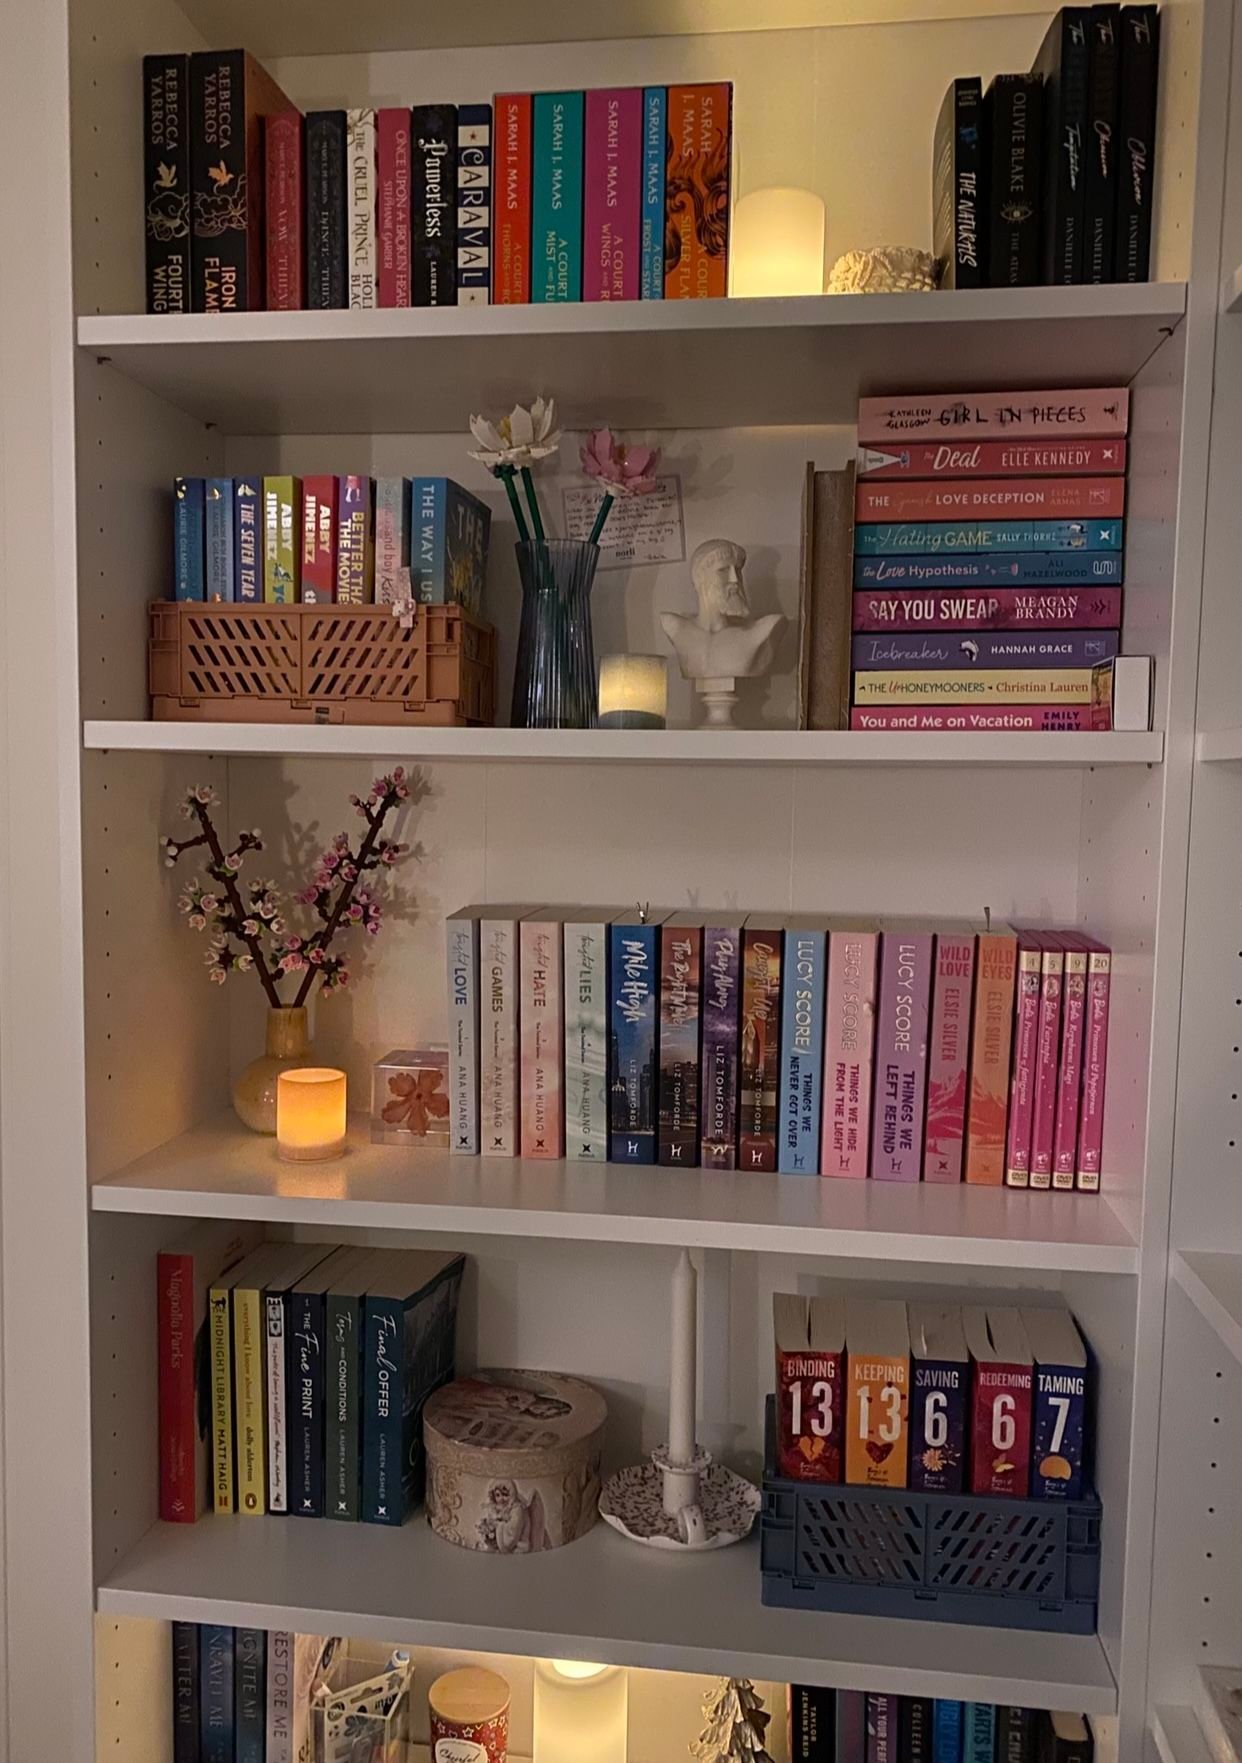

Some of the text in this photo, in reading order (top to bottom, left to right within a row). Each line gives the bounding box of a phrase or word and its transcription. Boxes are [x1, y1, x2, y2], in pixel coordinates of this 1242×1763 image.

[152, 76, 164, 145] YARROS
[166, 69, 178, 150] REBECCA
[204, 74, 218, 144] YARROS
[218, 66, 231, 149] REBECCA
[682, 94, 695, 158] J. MAAS
[701, 97, 712, 152] SARAH
[507, 104, 519, 210] SARAH J. MAAS
[552, 104, 564, 211] SARAH J. MAAS
[606, 100, 619, 208] SARAH J. MAAS
[648, 98, 660, 205] SARAH J. MAAS
[1010, 92, 1026, 193] OLIVIE BLAKE
[354, 155, 369, 267] CRUEL PRINCE
[418, 138, 448, 238] Powerless
[462, 148, 485, 285] CARAVAL
[958, 172, 978, 268] THE NATURALS
[558, 239, 569, 298] A COURT
[600, 223, 612, 268] WINGS
[153, 266, 167, 312] WING
[221, 267, 236, 308] IRON
[430, 262, 438, 298] LAUREN
[613, 250, 624, 296] COURT
[653, 255, 662, 293] COURT
[938, 405, 1087, 427] GIRL IN PIECES
[932, 446, 982, 471] Deal
[1002, 450, 1092, 467] ELLE KENNEDY
[421, 484, 434, 562] THE WAY
[868, 492, 1045, 508] THE LOVE DECEPTION
[266, 492, 278, 560] JIMENEZ
[281, 503, 292, 552] ABBY
[304, 494, 316, 564] JIMENEZ
[320, 504, 331, 554] ABBY
[339, 518, 352, 549] THE
[351, 512, 364, 572] BETTER
[878, 525, 992, 551] Hating GAME
[180, 538, 188, 580] GILMORE
[241, 504, 255, 598] THE SEVEN YEAR
[876, 561, 980, 581] Love Hypothesis
[869, 598, 1000, 621] SAY YOU SWEAR
[1014, 596, 1079, 607] MEAGAN
[1015, 608, 1078, 619] BRANDY
[868, 640, 949, 662] Icebreaker
[990, 644, 1073, 654] HANNAH GRACE
[868, 682, 888, 694] THE
[996, 682, 1089, 694] Christina Lauren
[860, 714, 1034, 728] You and Me on Vacation
[1044, 711, 1080, 721] EMILY
[939, 962, 970, 979] LOVE
[940, 945, 972, 962] WILD
[1049, 958, 1056, 969] 5
[1074, 958, 1081, 969] 9
[1094, 958, 1108, 969] 20
[454, 968, 468, 1006] LOVE
[492, 966, 504, 1014] GAMES
[533, 970, 546, 1008] HATE
[579, 970, 592, 1005] LIES
[616, 940, 648, 1023] Mile High
[794, 940, 814, 1047] LUCY SCORE
[894, 944, 916, 1052] LUCY SCORE
[941, 988, 960, 1062] ELSIE SILVER
[459, 1065, 468, 1088] ANA
[494, 1065, 502, 1088] ANA
[536, 1068, 544, 1091] ANA
[630, 1059, 638, 1126] LIZ TOMFORDE
[673, 1063, 682, 1132] LIZ TOMFORDE
[715, 1046, 725, 1136] LIZ TOMFORDE
[459, 1092, 468, 1130] HUANG
[494, 1092, 503, 1129] HUANG
[536, 1094, 544, 1132] HUANG
[754, 1086, 762, 1137] TOMFORDE
[788, 1056, 800, 1148] NEVER GOT OVER
[801, 1072, 813, 1133] THINGS WE
[833, 1062, 846, 1152] FROM THE LIGHT
[848, 1063, 860, 1152] THINGS WE HIDE
[884, 1064, 898, 1154] LEFT BEHIND
[900, 1070, 916, 1151] THINGS WE
[170, 1332, 184, 1369] Parks
[295, 1312, 319, 1420] THE Fine PRINT
[372, 1314, 398, 1418] Final OFFER
[788, 1360, 835, 1378] BINDING
[855, 1364, 905, 1383] KEEPING
[215, 1316, 228, 1490] MIDNIGHT LIBRARY MATT HAIG
[338, 1359, 347, 1422] CONDITIONS
[916, 1370, 959, 1388] SAVING
[980, 1372, 1032, 1389] REDEEMING
[1038, 1374, 1084, 1396] TAMING
[788, 1381, 833, 1437] 13
[856, 1385, 901, 1442] 13
[924, 1390, 948, 1448] 6
[992, 1394, 1016, 1450] 6
[1048, 1396, 1070, 1454] 7
[274, 1716, 288, 1739] ME
[876, 1696, 888, 1738] ALL YOUR
[911, 1704, 922, 1754] COLLEEN
